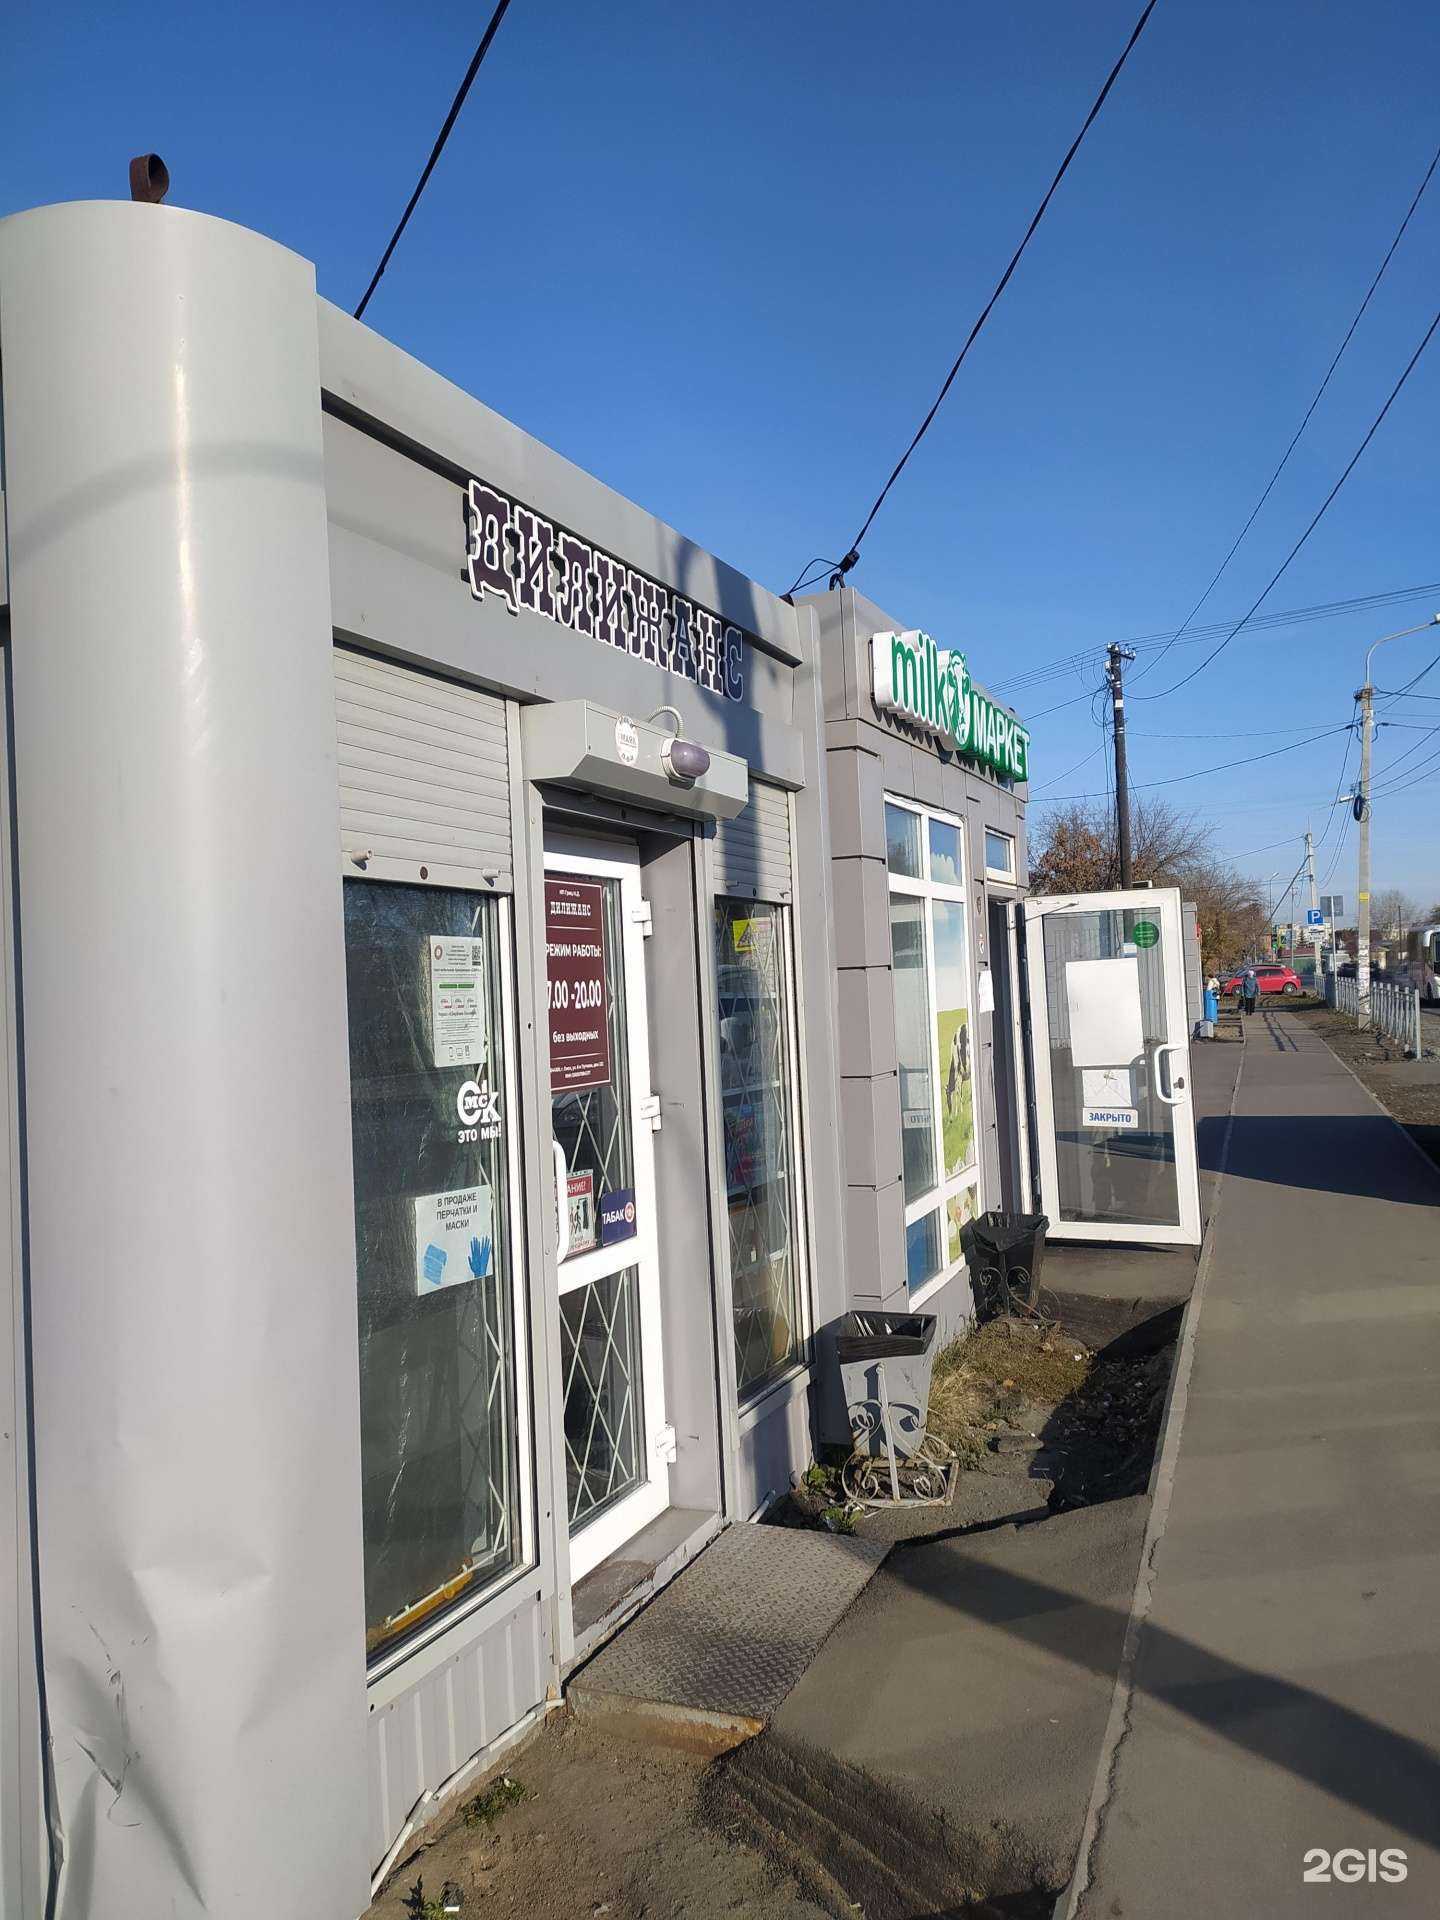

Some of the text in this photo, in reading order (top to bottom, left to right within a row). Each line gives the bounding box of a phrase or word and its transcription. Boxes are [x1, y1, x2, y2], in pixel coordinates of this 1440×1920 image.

[468, 479, 744, 702] ДИЛИЖАНС
[891, 633, 949, 734] milk
[974, 695, 1030, 777] МАРКЕТ
[550, 901, 591, 916] ДИЛИЖАНС
[546, 944, 602, 957] РЕЖИМ РАБОТЫ:
[552, 1029, 599, 1043] без выходных
[1088, 1111, 1131, 1123] ЗАКРЫТО
[457, 1129, 477, 1143] ЭТО
[437, 1192, 477, 1207] В ПРОДАЖЕ
[437, 1205, 478, 1220] ПЕРЧАТКИ И
[602, 1209, 625, 1225] ТАБАК
[445, 1219, 470, 1232] МАСКИ
